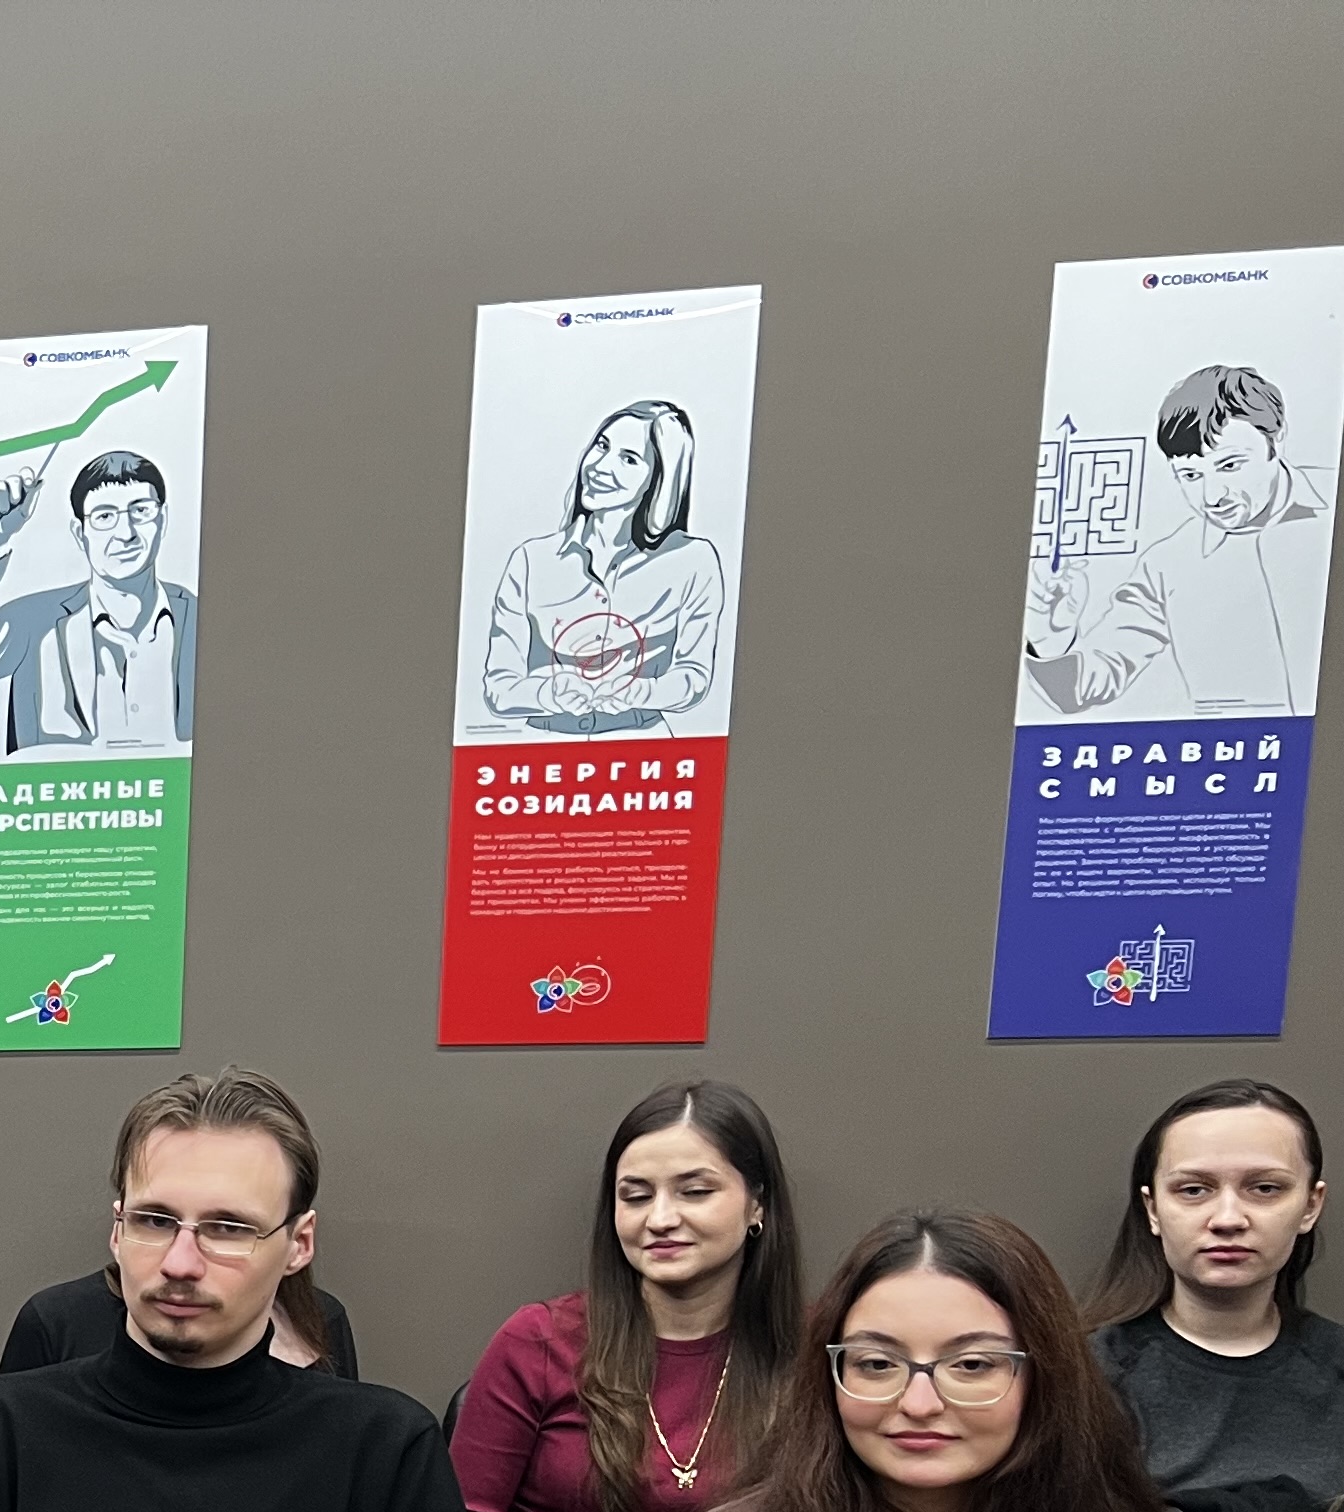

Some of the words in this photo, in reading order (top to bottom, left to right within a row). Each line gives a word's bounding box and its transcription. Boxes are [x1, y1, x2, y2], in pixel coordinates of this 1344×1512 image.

[1161, 269, 1269, 287] СОВКОМБАНК
[39, 347, 131, 363] СОВКОМБАНК
[1041, 733, 1281, 769] ЗДРАВЫЙ
[476, 759, 696, 786] ЭНЕРГИЯ
[1038, 771, 1278, 799] СМЫСЛ
[474, 790, 694, 816] СОЗИДАНИЯ
